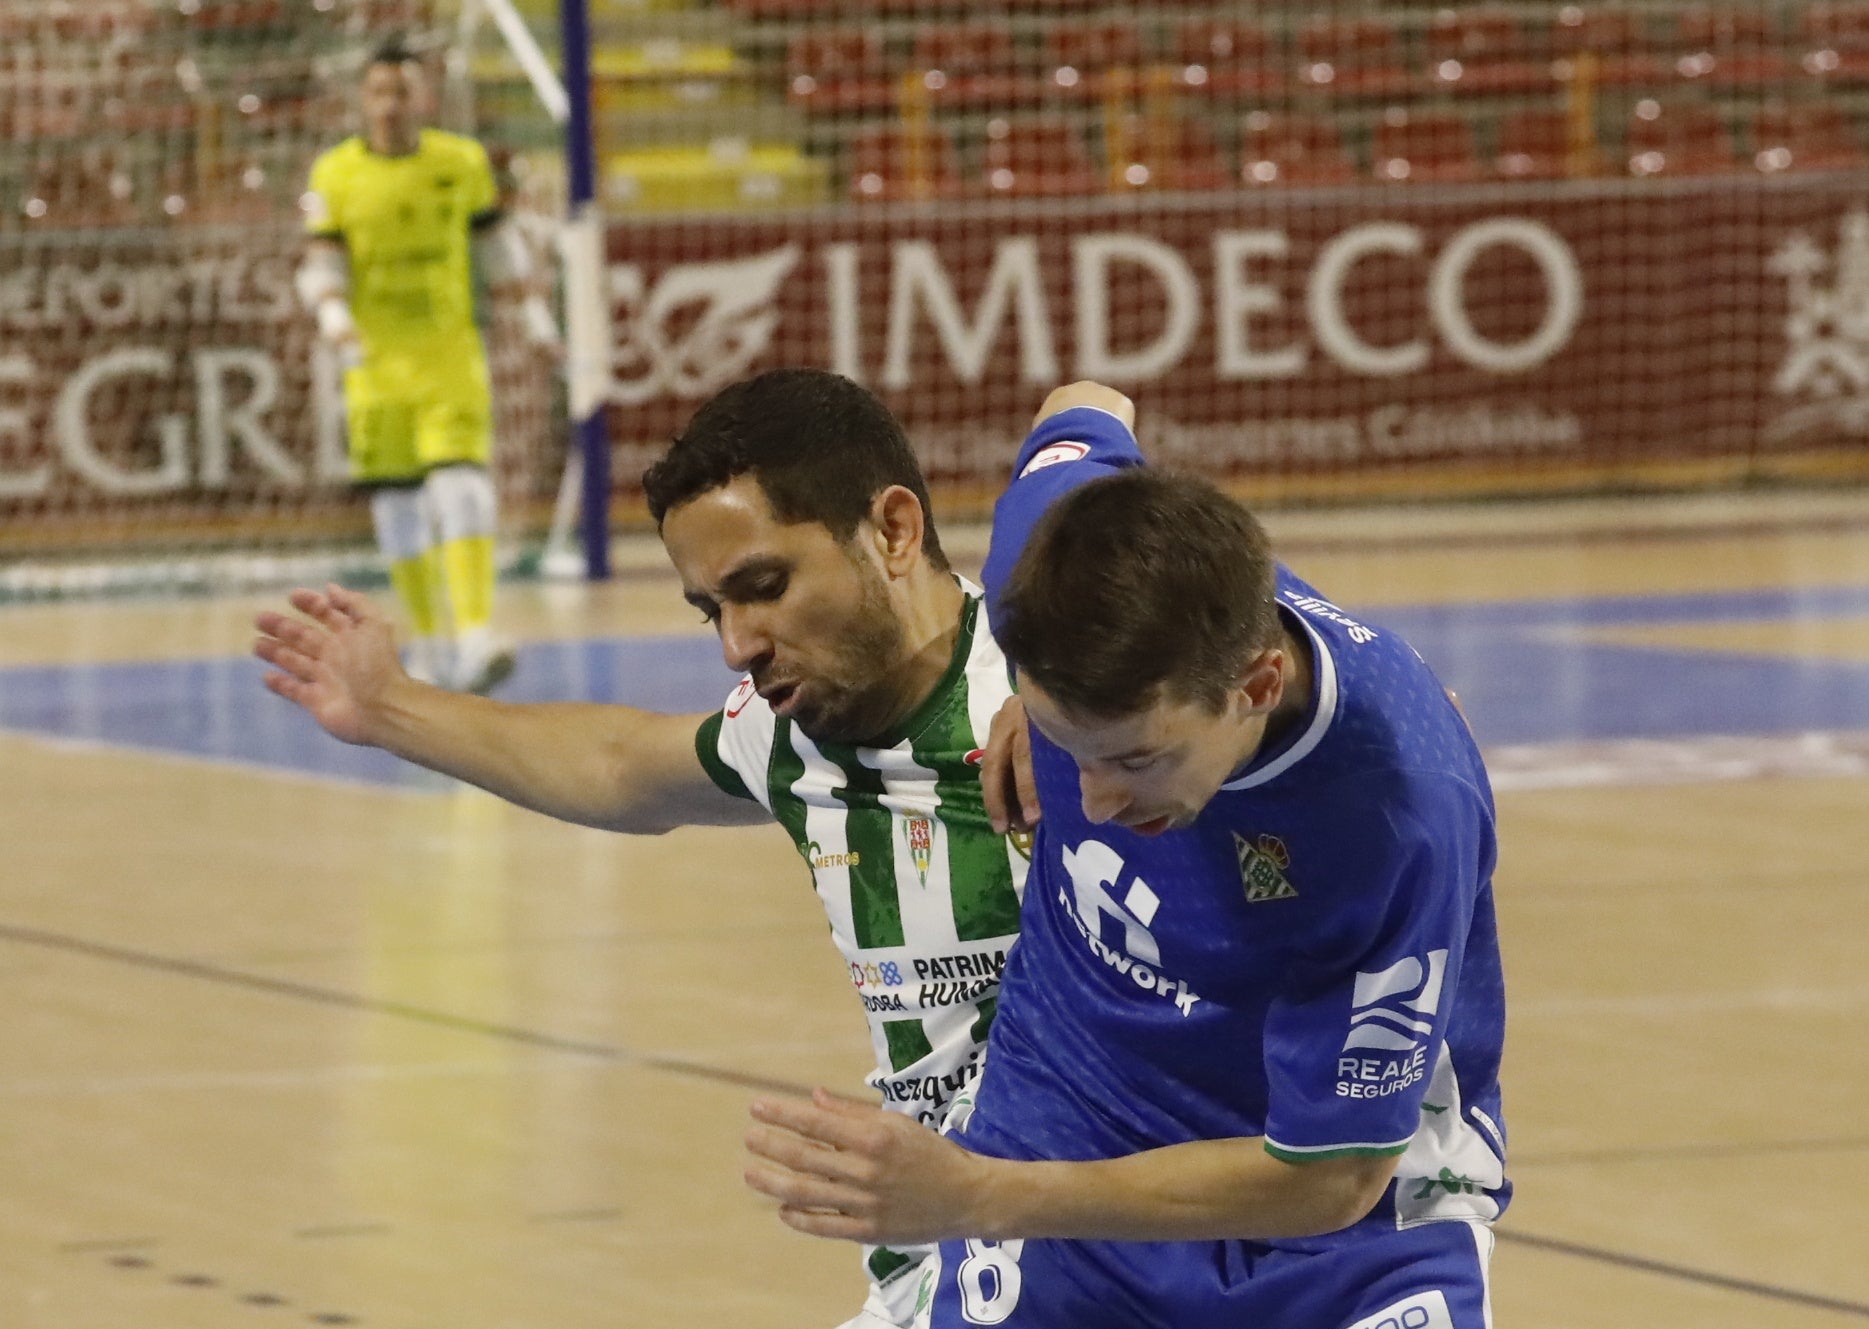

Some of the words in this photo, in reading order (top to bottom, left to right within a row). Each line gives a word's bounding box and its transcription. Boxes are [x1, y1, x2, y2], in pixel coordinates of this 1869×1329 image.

[826, 216, 1583, 388] IMDECO
[815, 851, 860, 868] METROS
[1336, 1045, 1428, 1081] REALE
[1335, 1068, 1424, 1099] SEGUROS
[957, 1238, 1025, 1326] 8
